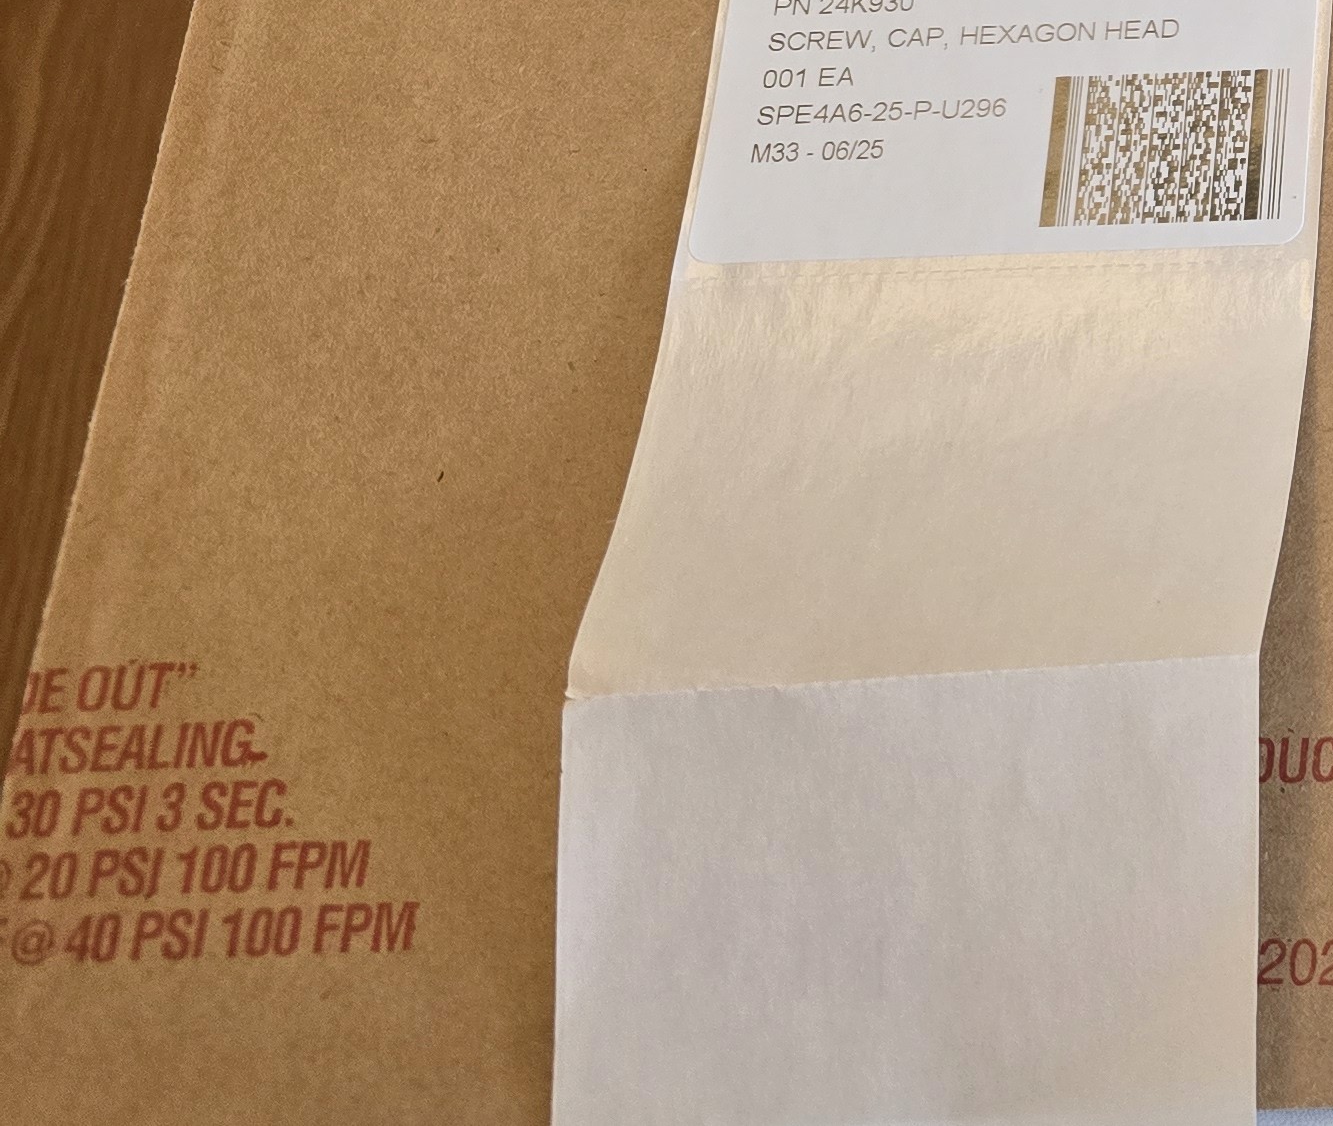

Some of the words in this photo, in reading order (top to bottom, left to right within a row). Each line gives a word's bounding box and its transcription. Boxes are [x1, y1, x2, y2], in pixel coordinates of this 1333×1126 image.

[767, 29, 876, 53] SCREW,
[887, 27, 948, 51] CAP,
[959, 21, 1097, 46] HEXAGON
[1104, 18, 1180, 41] HEAD
[762, 67, 807, 89] 001
[817, 66, 854, 87] EA
[756, 97, 1007, 126] SPE4A6-25-P-U296
[750, 141, 800, 164] M33
[821, 139, 885, 161] 06/25
[6, 789, 62, 841] 30
[72, 786, 149, 835] PSI
[156, 783, 186, 832] 3
[195, 779, 292, 830] SEC.
[18, 852, 80, 902] 20
[88, 847, 164, 897] PSI
[178, 843, 258, 895] 100
[267, 840, 370, 891] FPM
[62, 914, 122, 962] 40
[130, 909, 209, 960] PSI
[223, 906, 303, 957] 100
[314, 901, 418, 954] FPM
